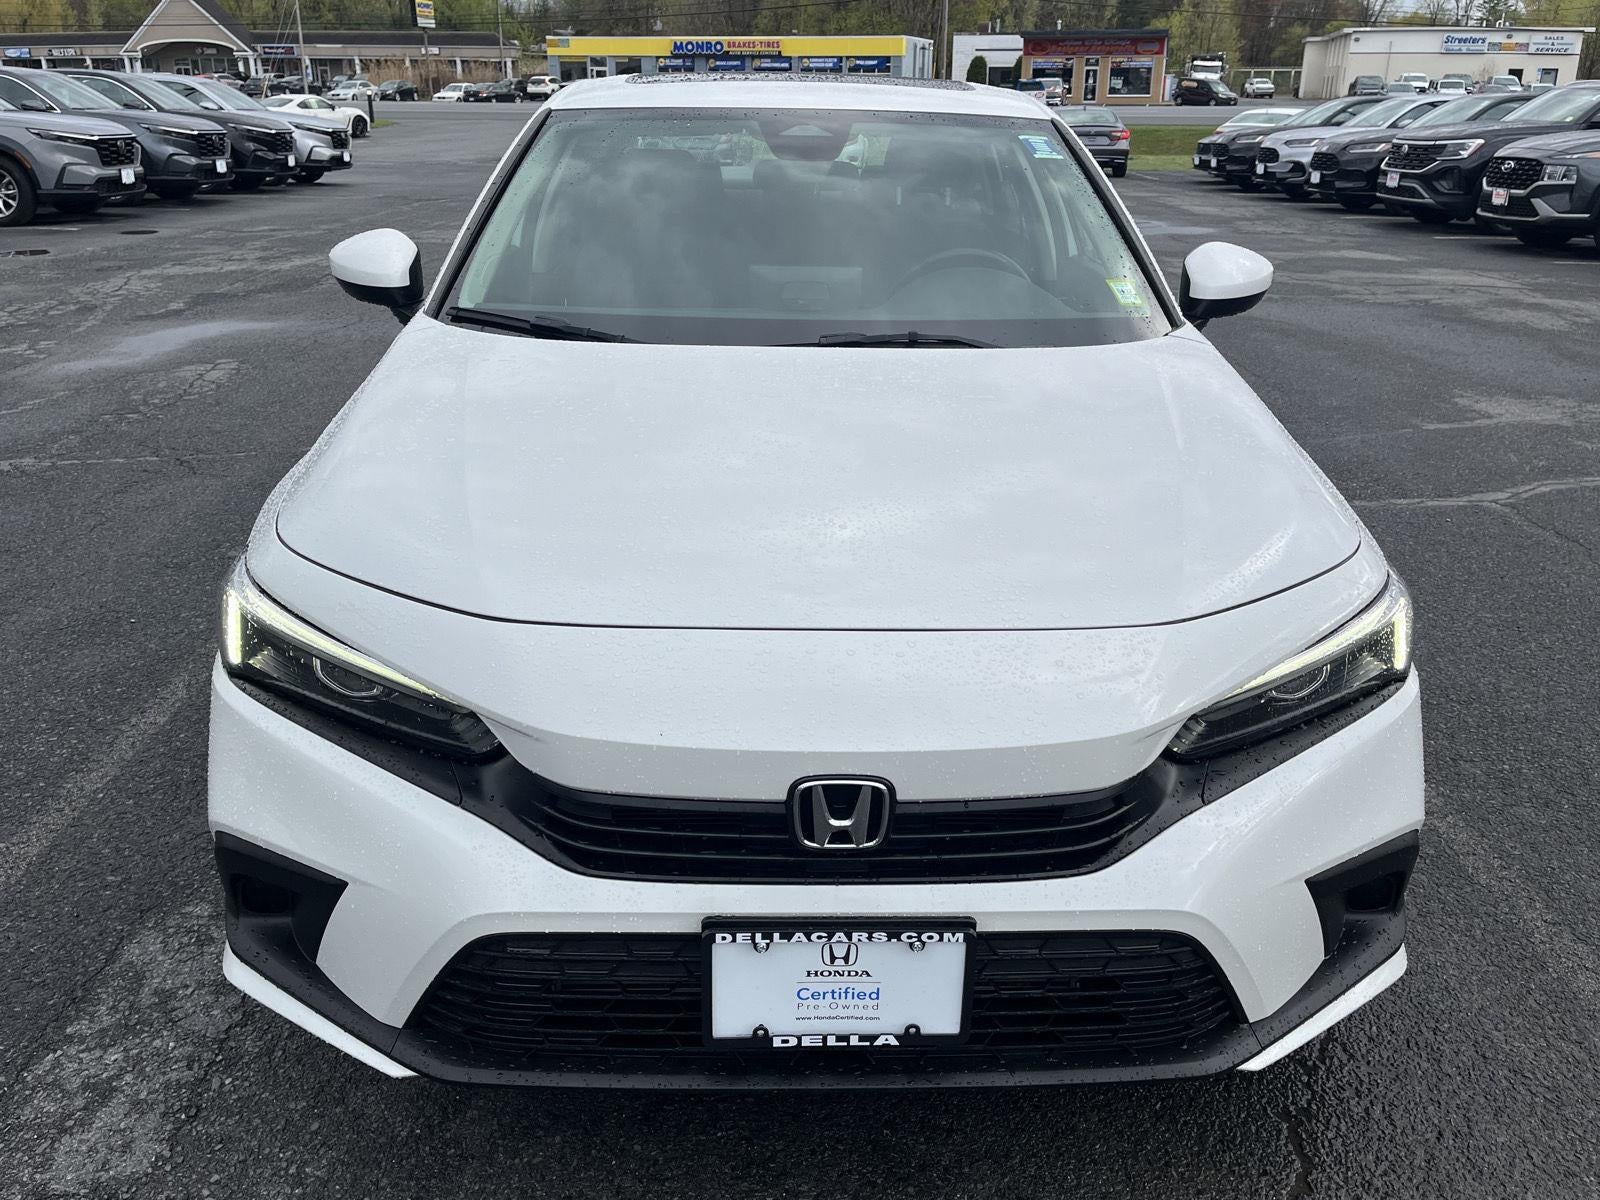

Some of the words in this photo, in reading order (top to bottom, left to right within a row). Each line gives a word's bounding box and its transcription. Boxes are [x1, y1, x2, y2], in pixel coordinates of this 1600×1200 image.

[1444, 35, 1487, 44] Streeters
[672, 40, 725, 54] MONRO
[715, 932, 964, 943] DELLACARS.COM
[796, 987, 880, 1001] Certified
[797, 1002, 879, 1010] Pre-Owned
[772, 1034, 900, 1047] DELLA
